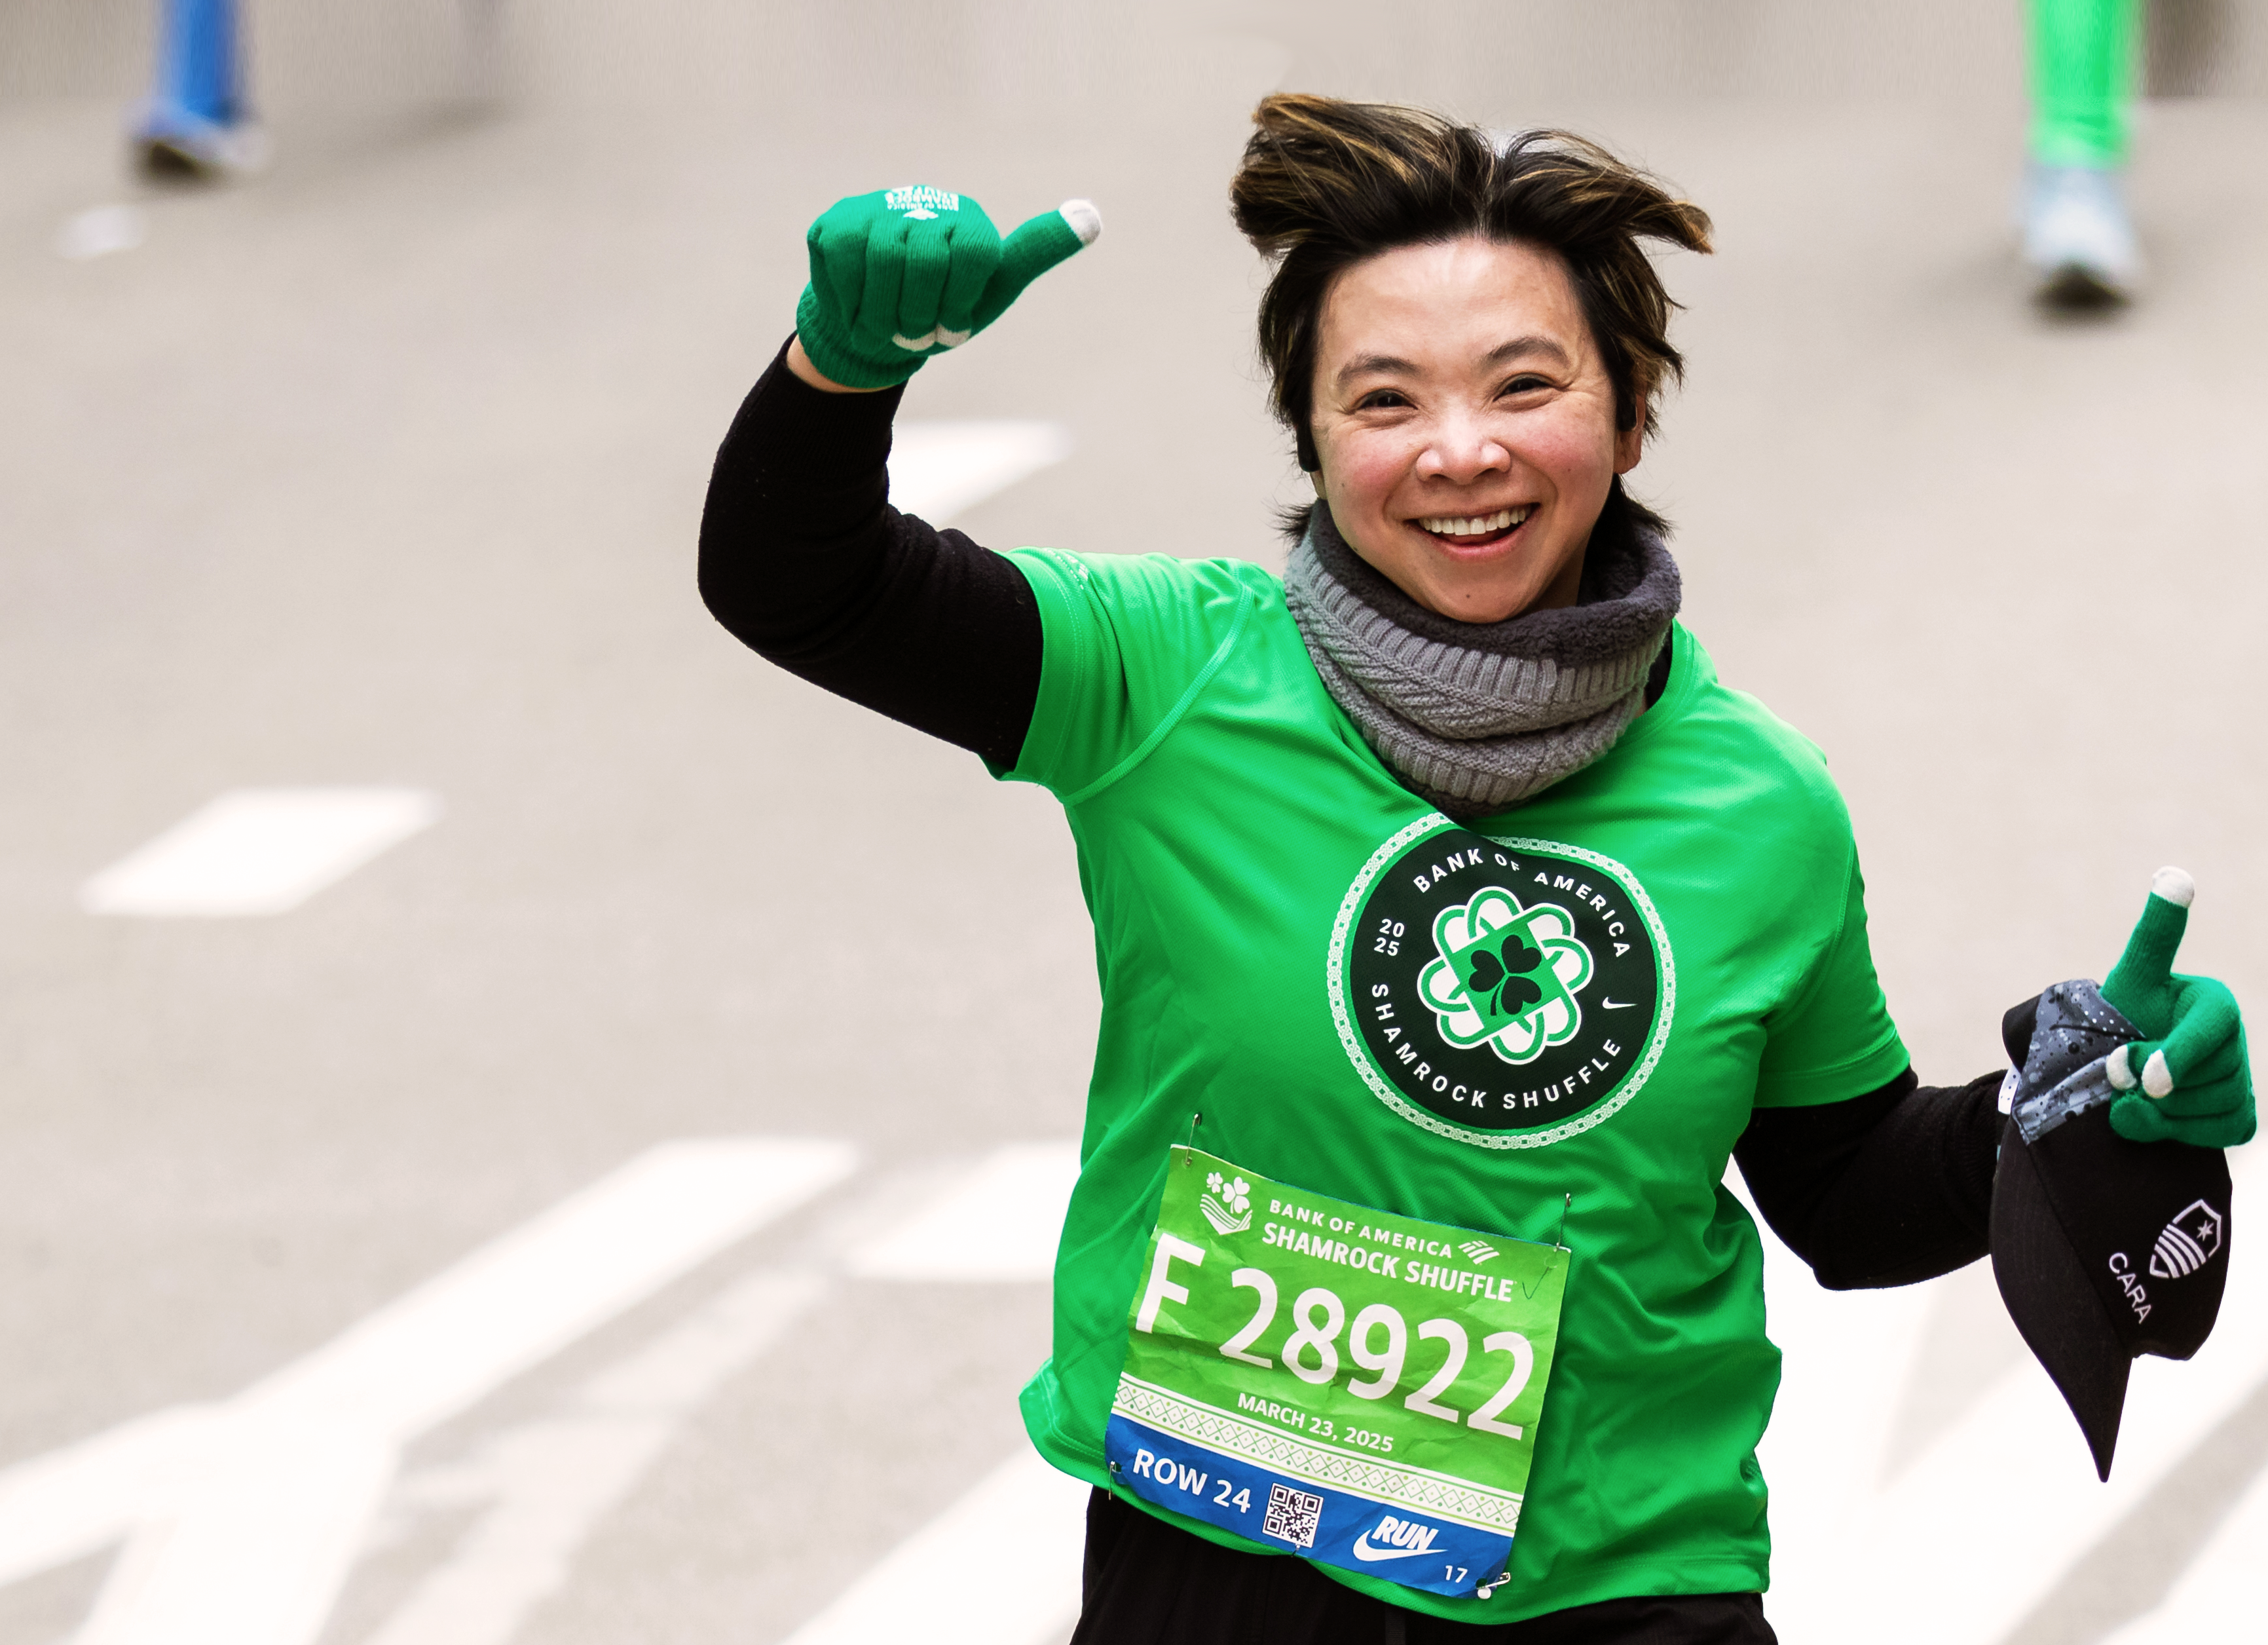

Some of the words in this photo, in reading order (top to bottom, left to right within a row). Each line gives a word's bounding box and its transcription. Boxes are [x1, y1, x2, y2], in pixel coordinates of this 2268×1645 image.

[1379, 918, 1405, 937] 20
[1413, 848, 1483, 893] BANK
[1495, 853, 1520, 871] OF
[1534, 872, 1630, 958] AMERICA
[1373, 937, 1400, 956] 25
[1371, 984, 1487, 1108] SHAMROCK
[1503, 1038, 1621, 1110] SHUFFLE
[1269, 1199, 1325, 1228] BANK
[1329, 1217, 1356, 1234] OF
[1358, 1224, 1452, 1258] AMERICA
[1261, 1222, 1399, 1279] SHAMROCK
[1404, 1260, 1514, 1303] SHUFFLE
[2109, 1253, 2151, 1323] CARA
[1135, 1232, 1206, 1334] F
[1219, 1267, 1534, 1441] 28922
[1237, 1392, 1306, 1428] MARCH
[1308, 1416, 1338, 1441] 23,
[1343, 1426, 1394, 1452] 2025
[1133, 1448, 1208, 1496] ROW
[1213, 1479, 1251, 1513] 24
[1371, 1515, 1439, 1551] RUN
[1445, 1565, 1468, 1583] 17
